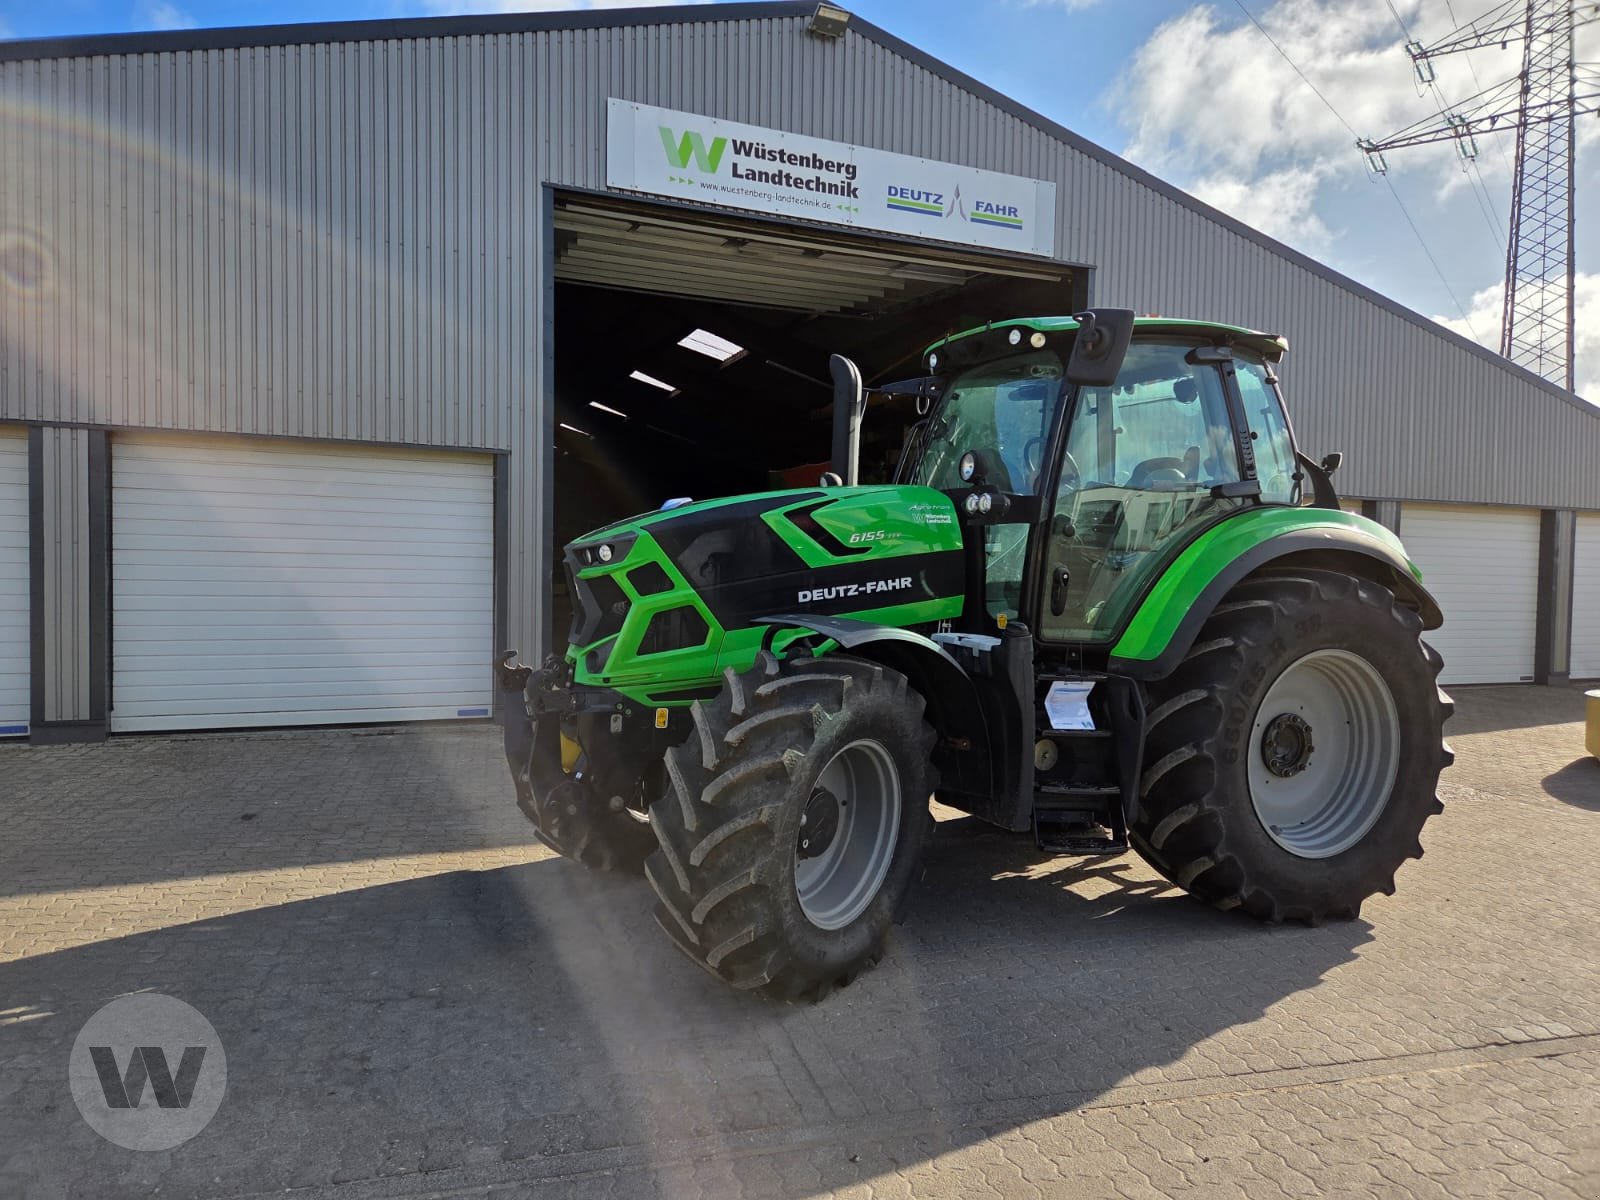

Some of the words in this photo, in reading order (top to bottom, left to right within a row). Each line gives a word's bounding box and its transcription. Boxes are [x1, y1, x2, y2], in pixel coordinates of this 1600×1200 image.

[731, 138, 857, 180] Wüstenberg
[700, 181, 832, 209] www.wuestenberg-landtechnik.de
[731, 162, 859, 199] Landtechnik
[887, 185, 943, 205] DEUTZ
[975, 200, 1018, 218] FAHR
[850, 530, 885, 543] 6155
[798, 576, 913, 603] DEUTZ-FAHR
